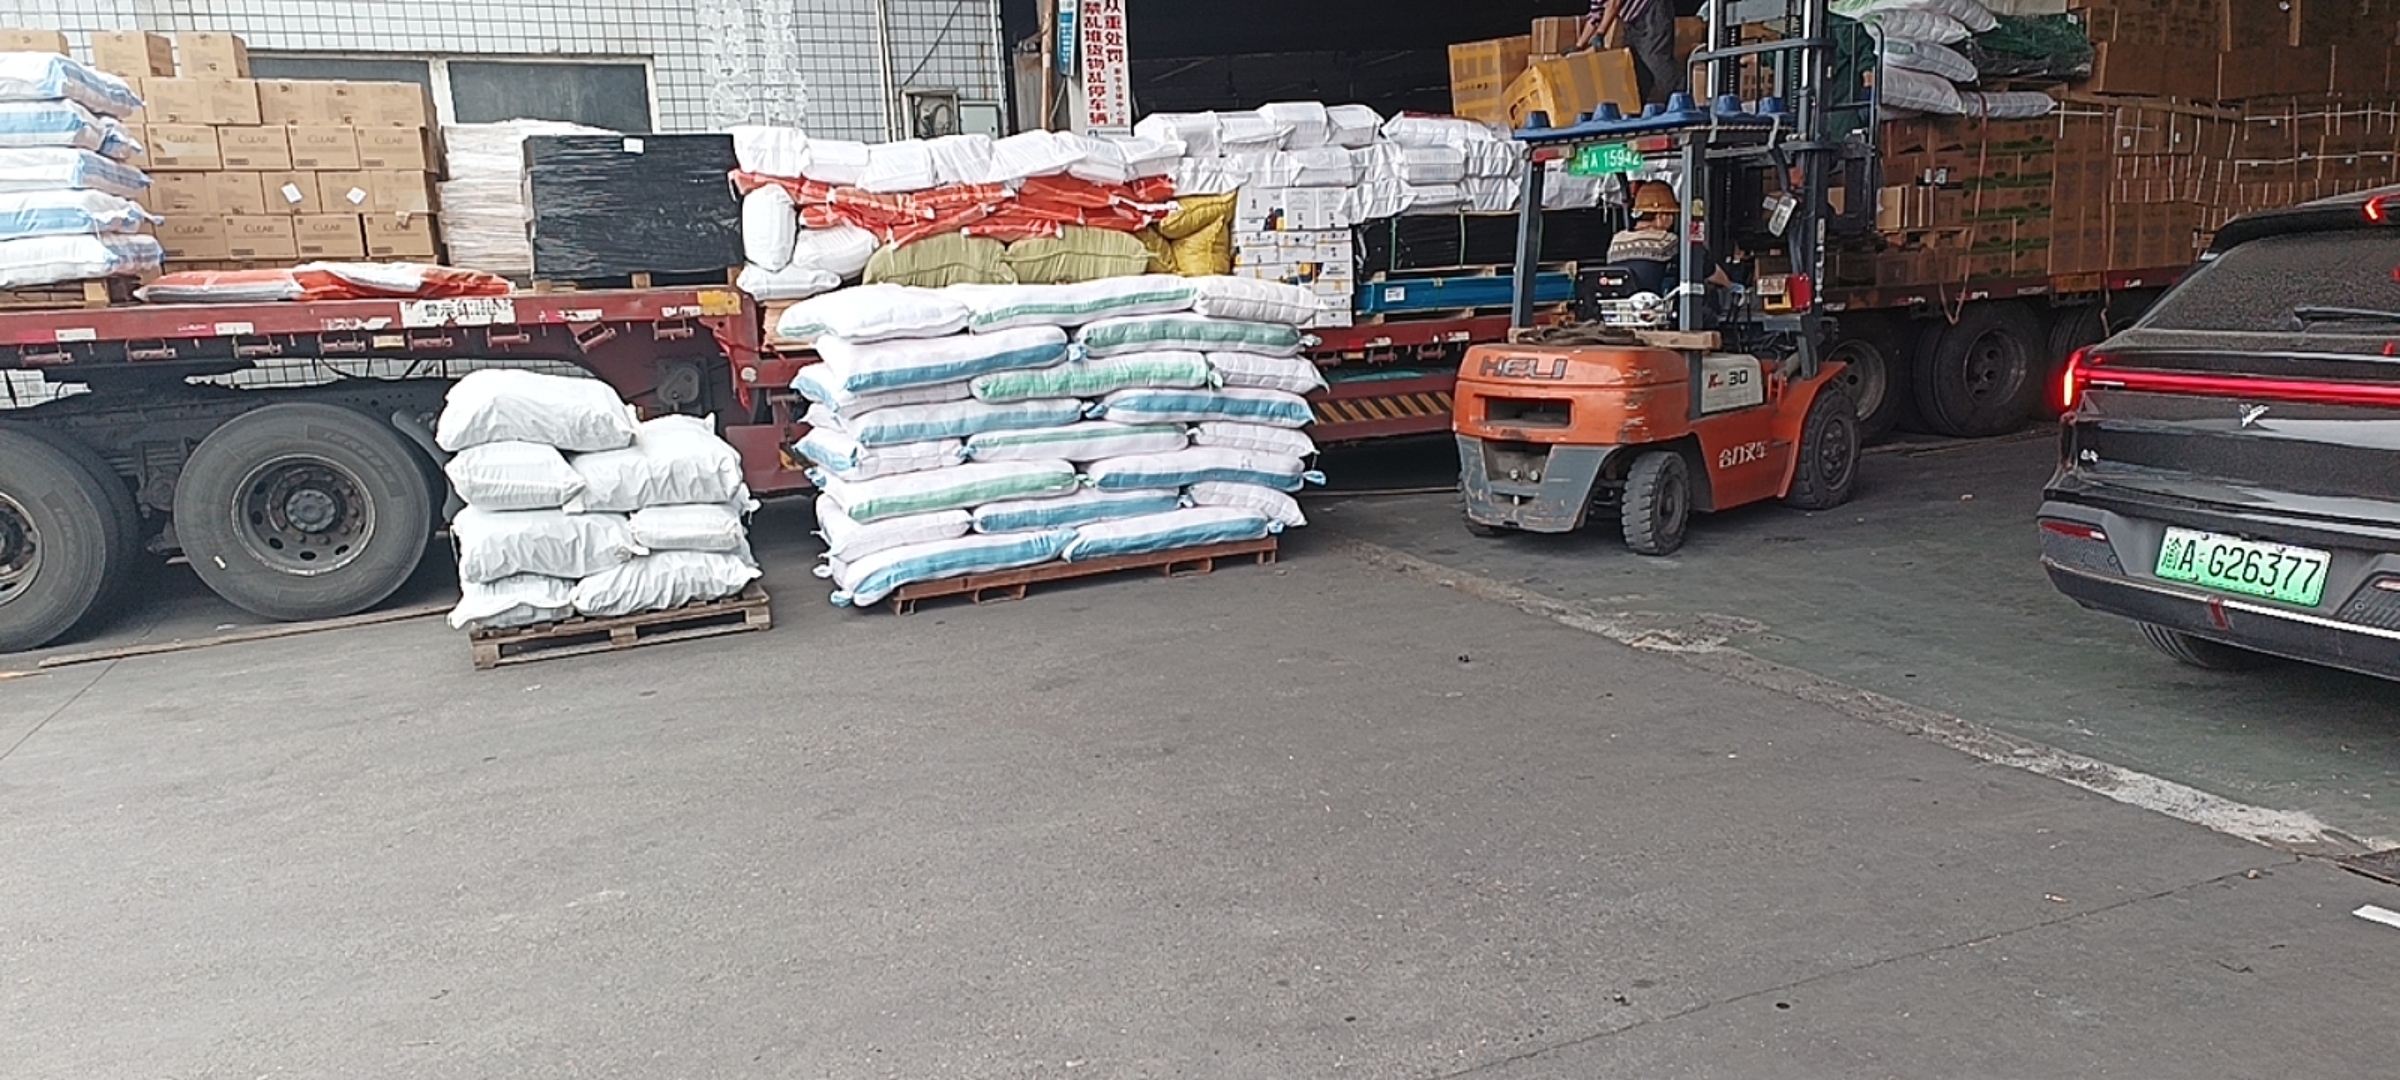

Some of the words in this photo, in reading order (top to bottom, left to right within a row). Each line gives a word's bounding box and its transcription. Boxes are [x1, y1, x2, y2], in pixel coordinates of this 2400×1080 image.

[1104, 0, 1123, 63] 从重处罚
[174, 224, 205, 234] CLEAR
[244, 224, 275, 233] CLEAR
[312, 223, 342, 232] CLEAR
[1480, 356, 1568, 380] HELI
[1728, 370, 1748, 386] 30
[1718, 441, 1769, 469] 合力叉车
